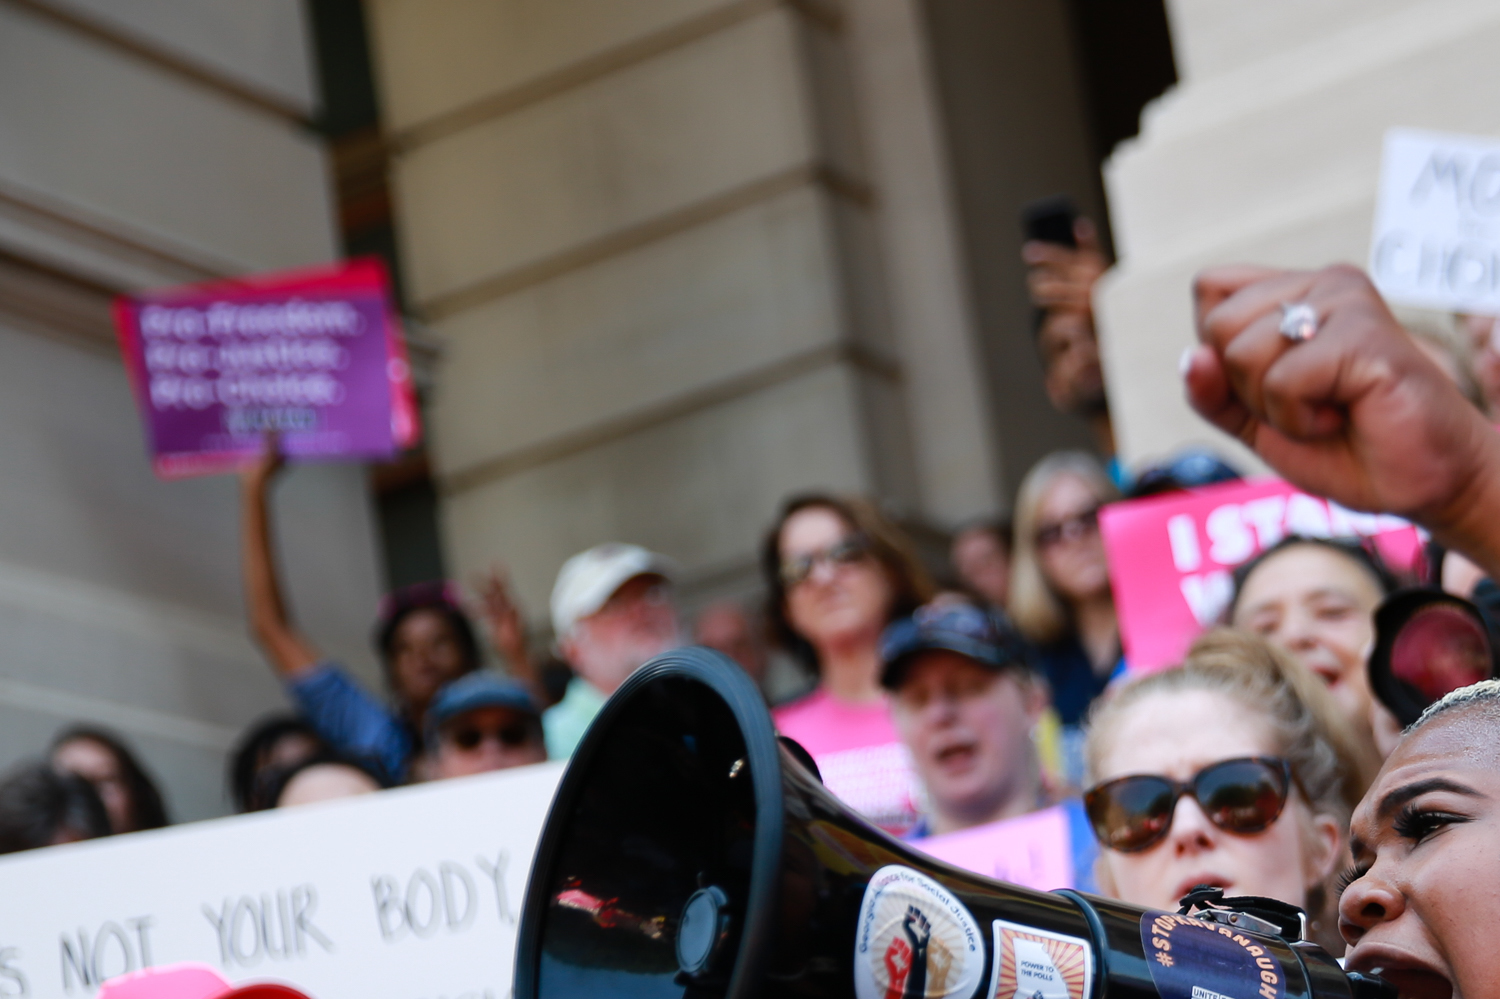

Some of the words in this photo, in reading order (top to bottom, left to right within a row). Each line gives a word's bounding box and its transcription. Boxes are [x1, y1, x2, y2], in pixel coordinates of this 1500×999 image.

[1167, 512, 1200, 573] I
[1205, 491, 1431, 566] STA
[58, 913, 157, 992] NOT
[201, 882, 338, 970] YOUR
[916, 875, 950, 907] Social
[949, 905, 976, 953] Justice
[1021, 960, 1044, 972] POWER
[1045, 966, 1055, 974] TO
[1021, 969, 1032, 978] THE
[1033, 971, 1054, 982] POLLS
